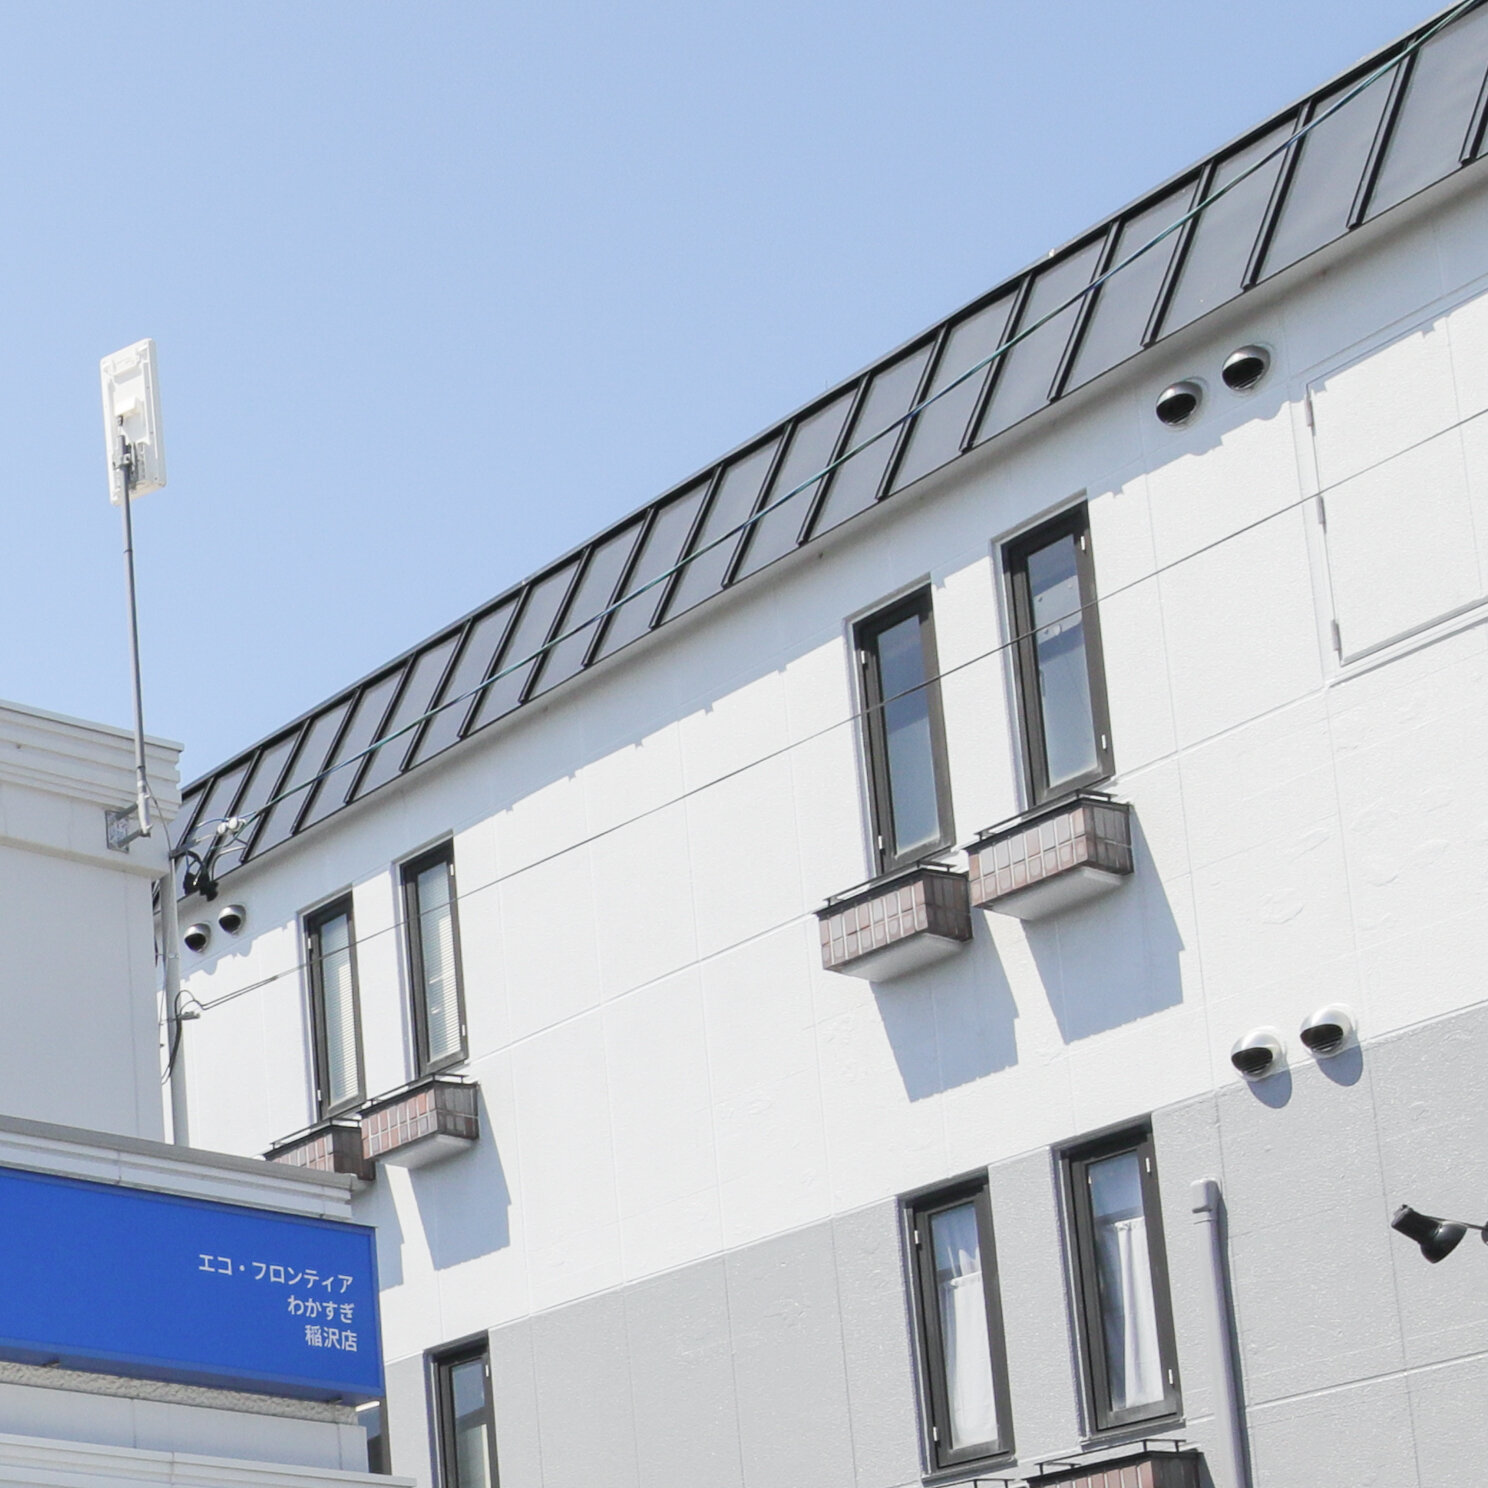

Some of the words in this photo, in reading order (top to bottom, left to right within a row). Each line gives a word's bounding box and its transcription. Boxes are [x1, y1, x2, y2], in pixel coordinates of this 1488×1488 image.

[198, 1254, 354, 1294] エコ・フロンティア
[287, 1295, 355, 1324] わかすぎ
[304, 1324, 358, 1352] 稲沢店
